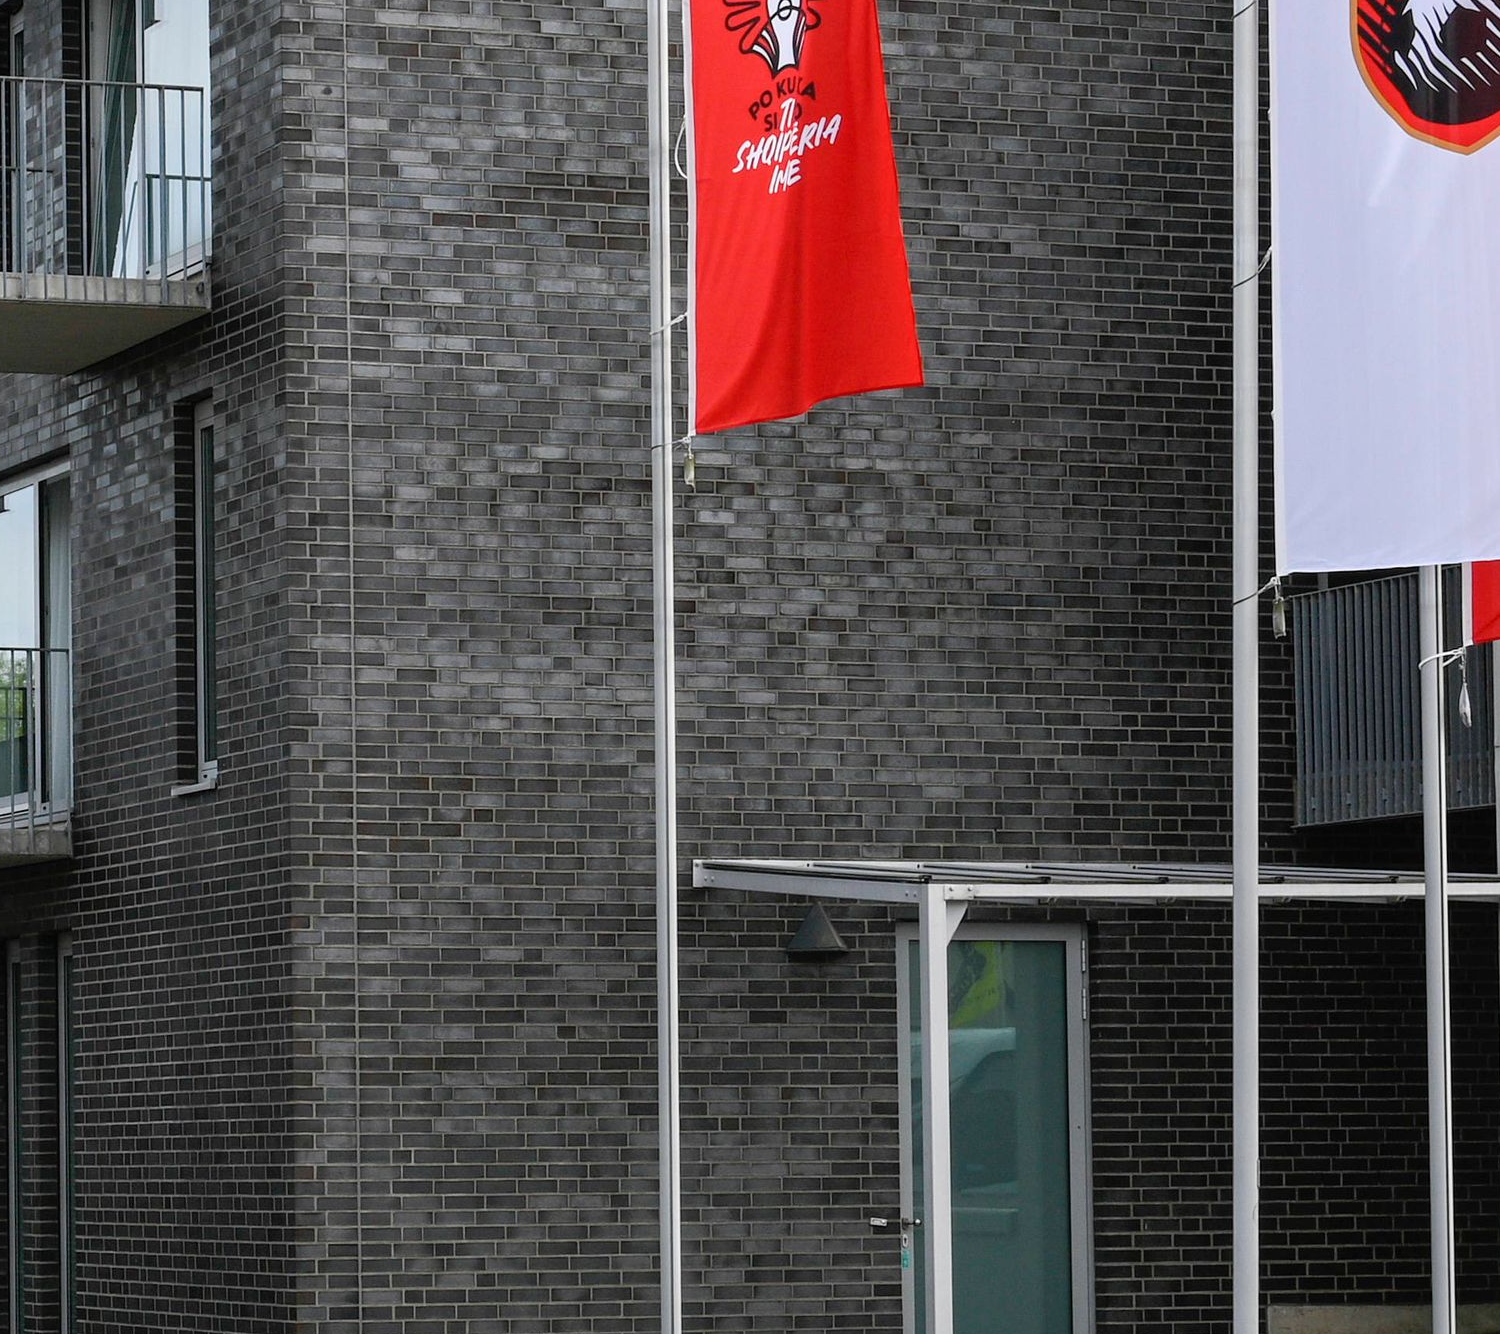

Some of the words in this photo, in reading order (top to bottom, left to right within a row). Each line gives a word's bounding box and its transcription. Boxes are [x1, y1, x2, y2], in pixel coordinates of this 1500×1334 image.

[748, 90, 773, 121] PO
[764, 112, 778, 132] SI
[769, 159, 802, 194] IME
